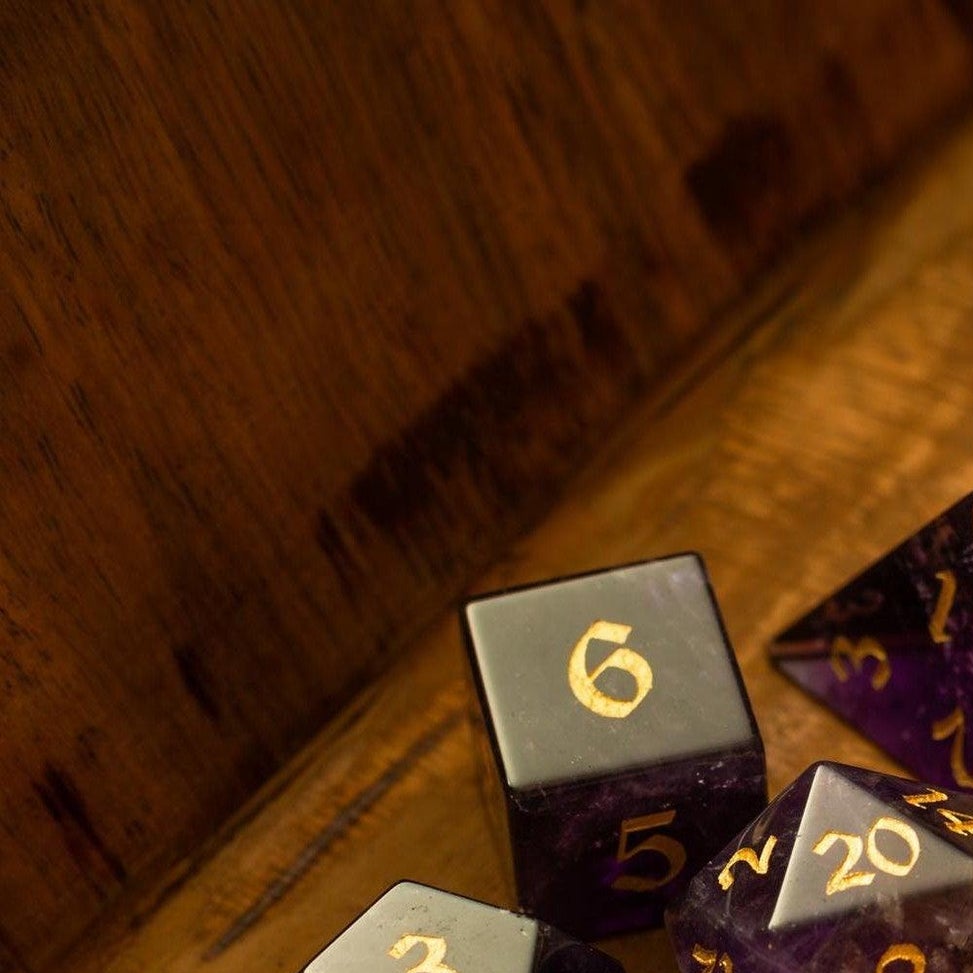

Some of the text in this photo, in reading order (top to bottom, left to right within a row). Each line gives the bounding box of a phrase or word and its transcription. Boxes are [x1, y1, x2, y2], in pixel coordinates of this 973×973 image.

[929, 570, 956, 643] 1
[568, 619, 654, 719] 6
[610, 810, 688, 892] 5
[717, 835, 778, 891] 2
[813, 816, 921, 895] 20
